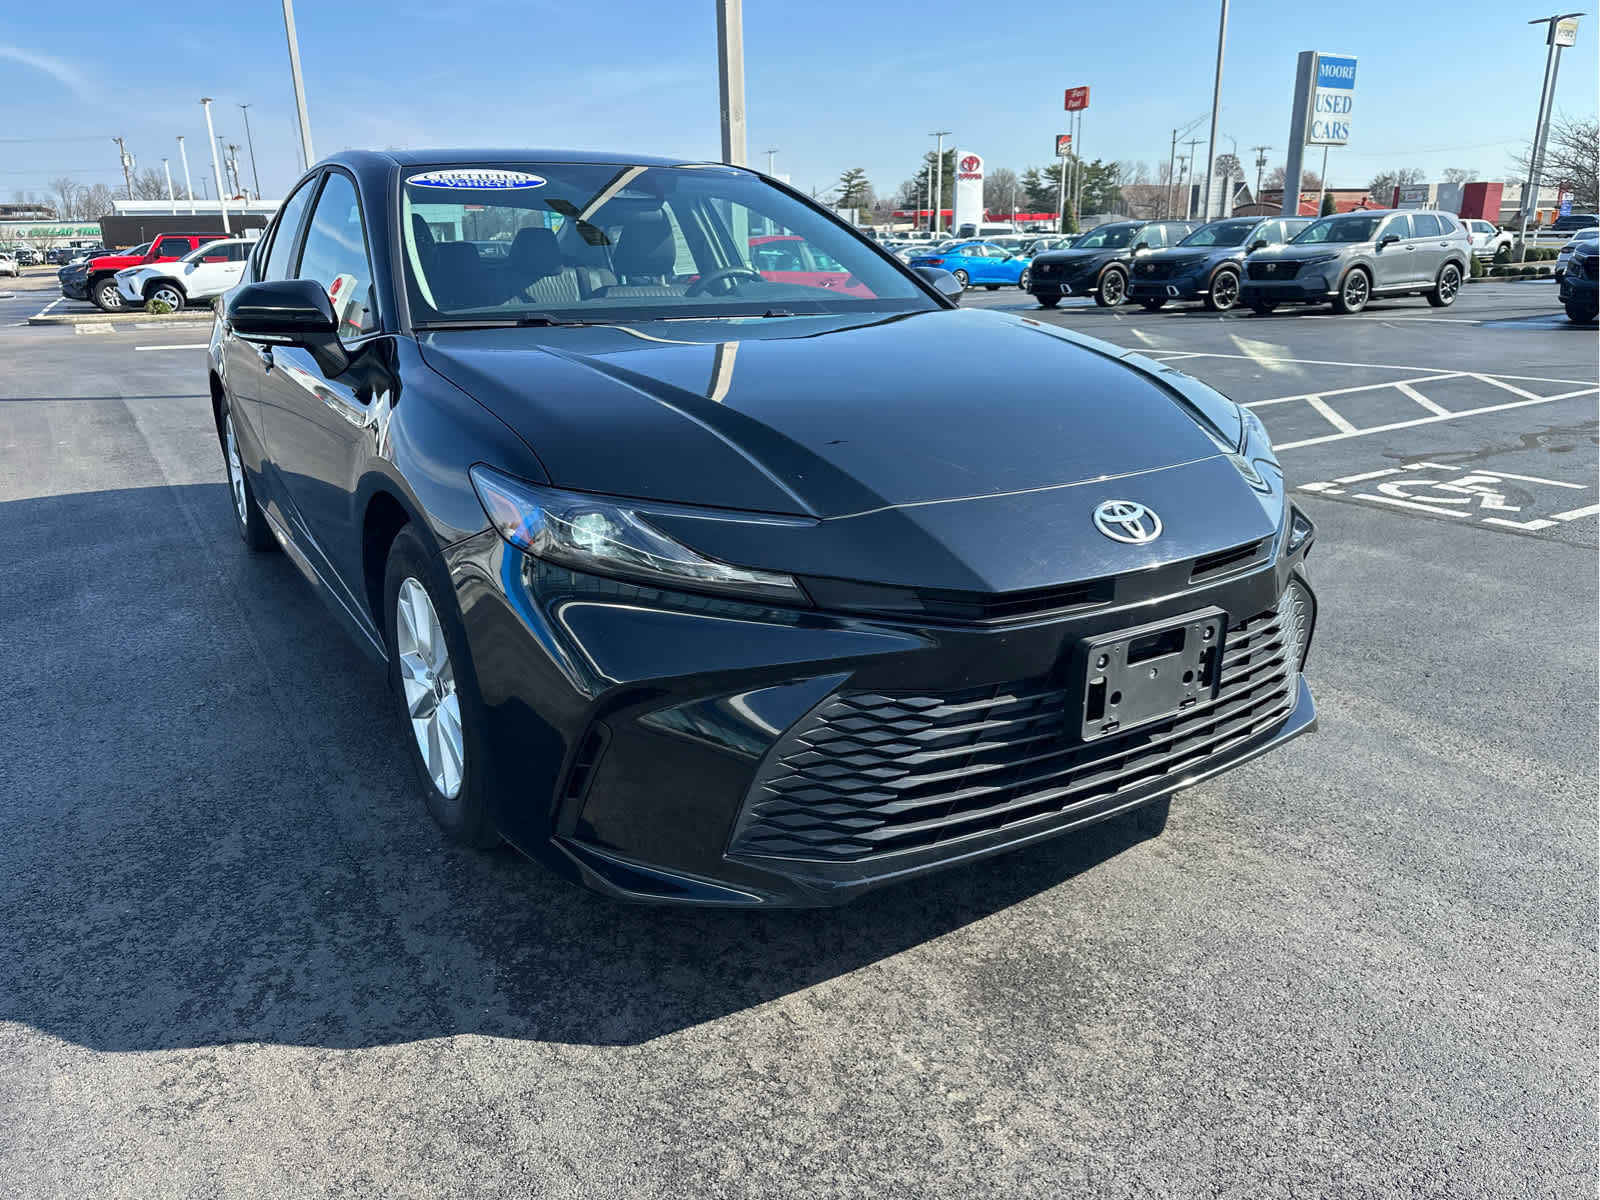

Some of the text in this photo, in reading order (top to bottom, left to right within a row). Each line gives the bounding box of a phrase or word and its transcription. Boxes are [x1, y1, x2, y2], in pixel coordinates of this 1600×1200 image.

[1320, 63, 1355, 80] MOORE
[1316, 94, 1352, 114] USED
[1312, 120, 1350, 140] CARS
